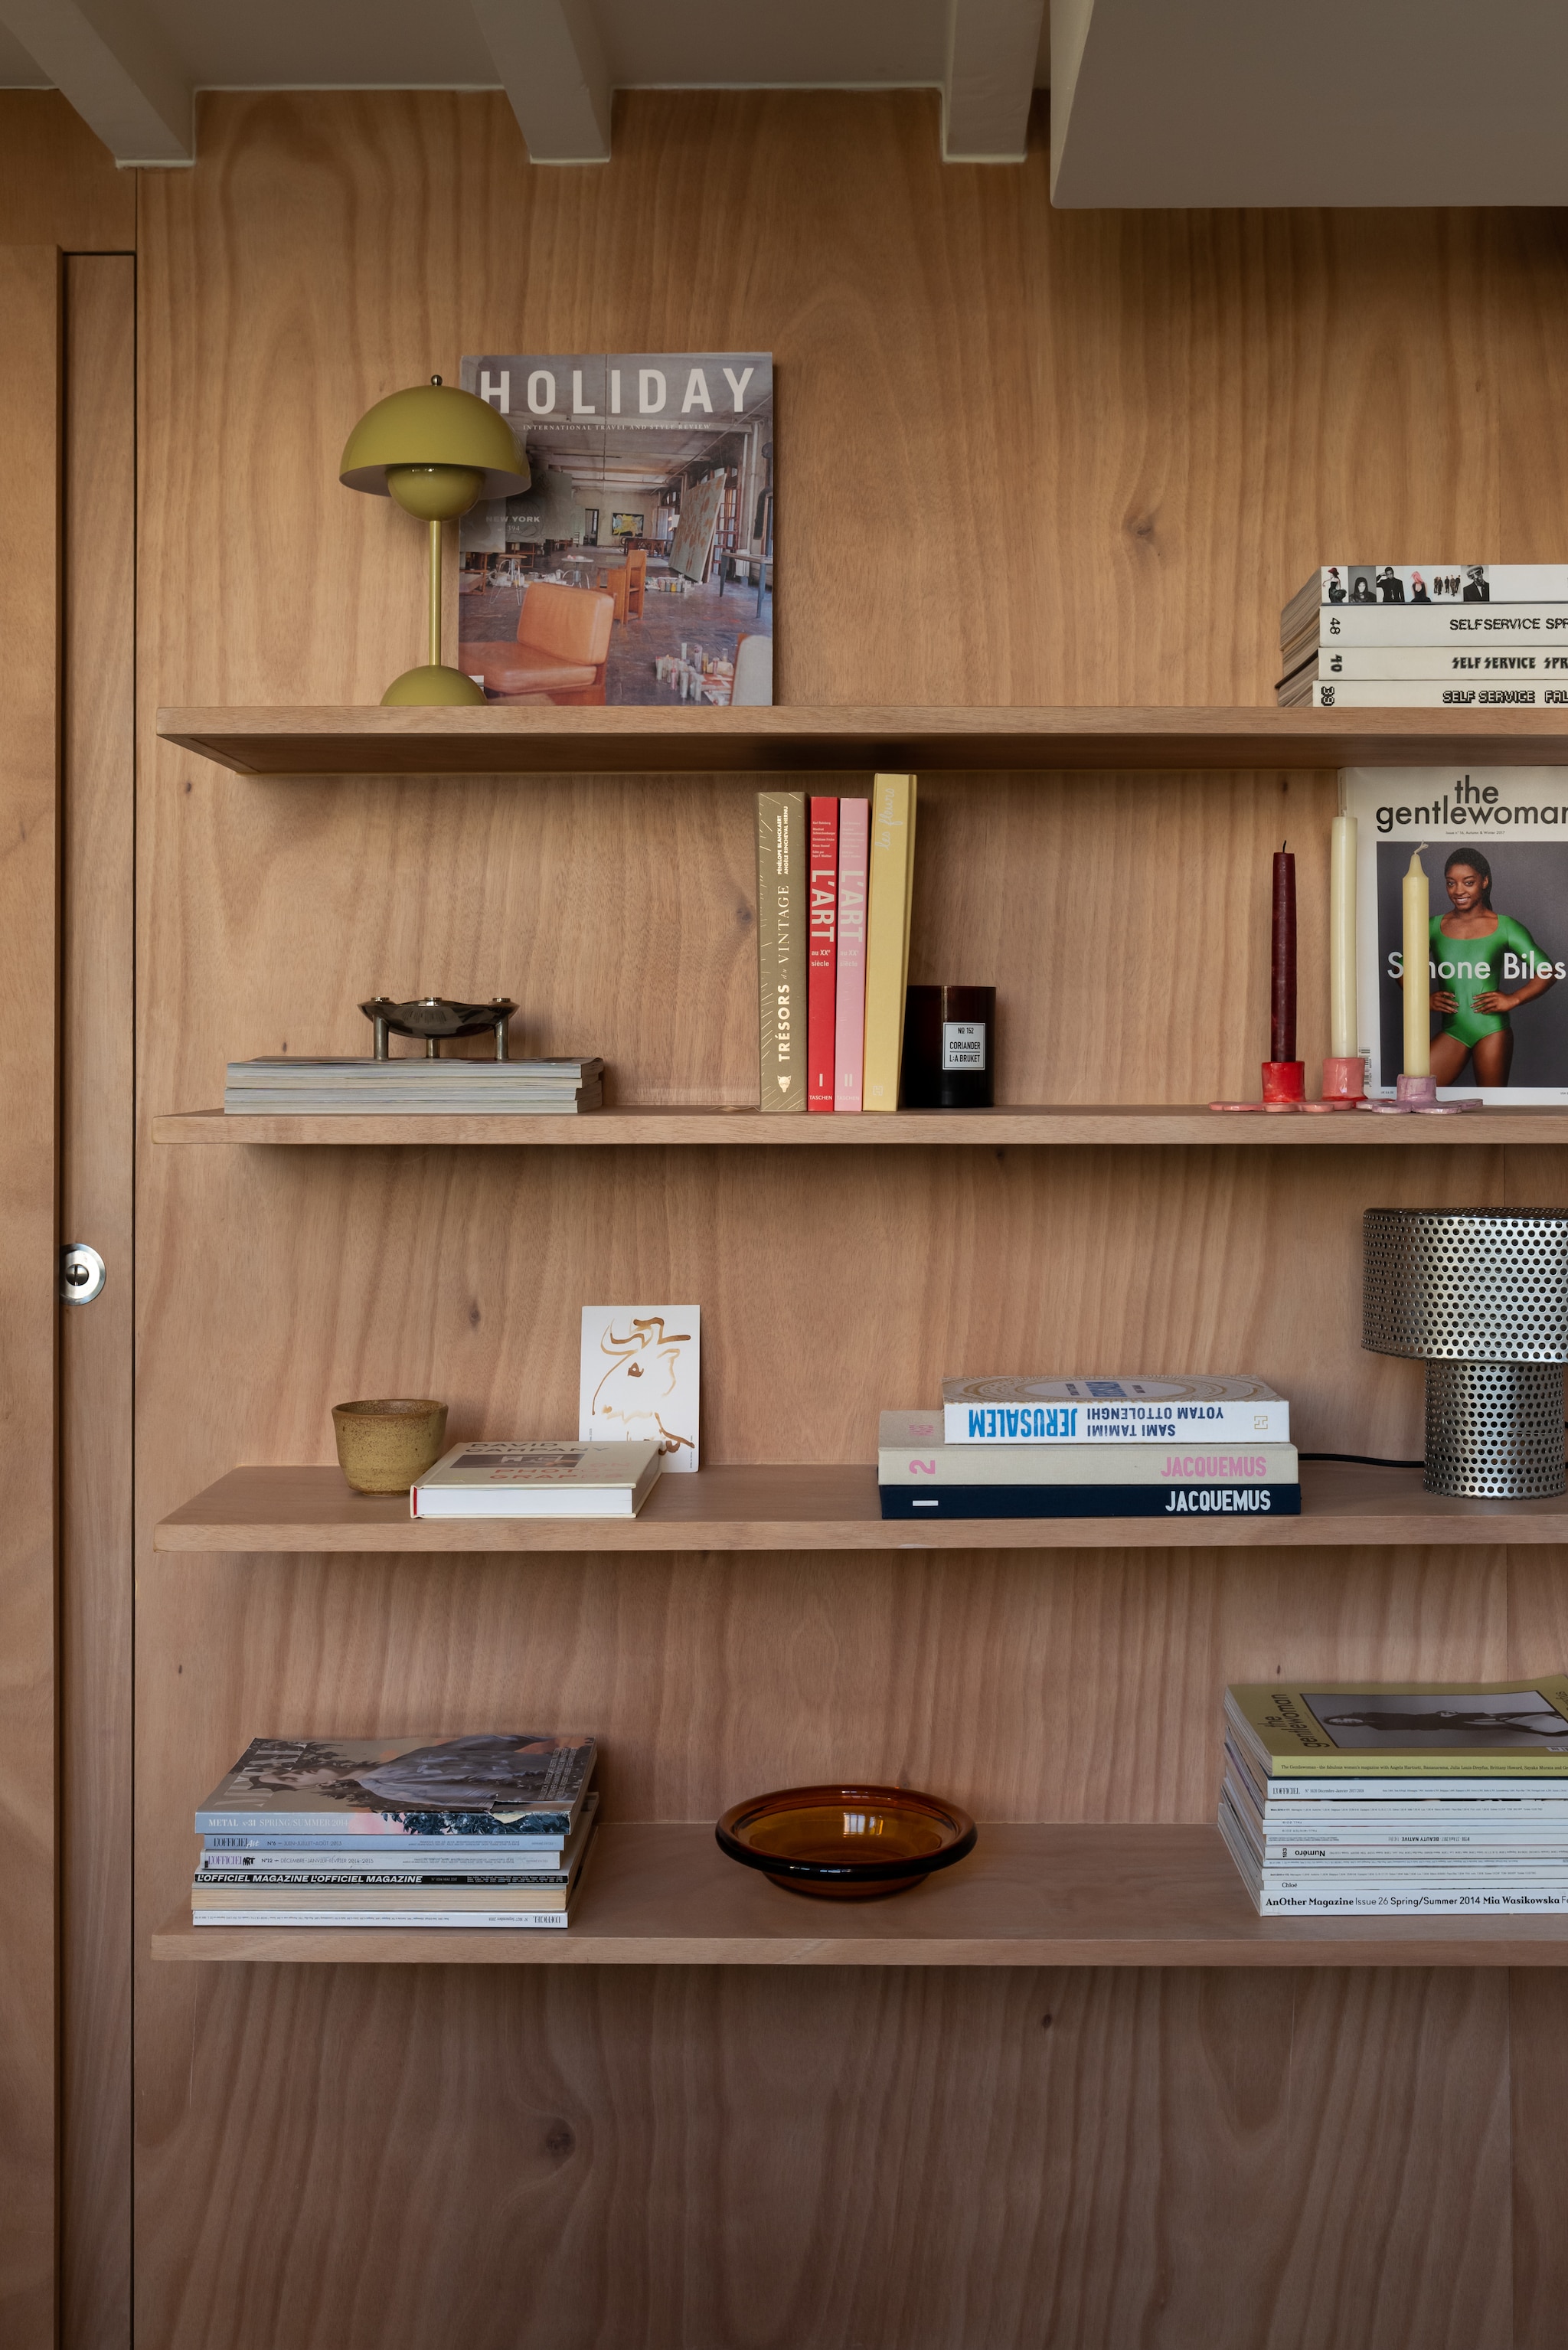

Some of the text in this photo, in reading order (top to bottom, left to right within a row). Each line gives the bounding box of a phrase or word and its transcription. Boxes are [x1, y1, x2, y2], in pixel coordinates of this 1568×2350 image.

[480, 367, 754, 414] HOLIDAY
[1330, 617, 1341, 636] 48
[1330, 654, 1343, 672] 40
[1452, 657, 1481, 669] SELF
[1484, 657, 1537, 669] SERVICE
[1321, 686, 1336, 706] 39
[1442, 690, 1476, 704] SELF
[1478, 690, 1536, 704] SERVICE
[1454, 774, 1499, 804] the
[874, 788, 903, 851] les fleurs
[812, 870, 835, 943] L'ART
[840, 870, 864, 943] L'ART
[778, 885, 789, 964] VINTAGE
[1387, 950, 1566, 979] Sone Biles
[775, 984, 790, 1062] TRÉSORS
[969, 1408, 1078, 1437] JERUSALEM
[1087, 1407, 1224, 1420] YOTAM OTTOLENGHI
[1087, 1423, 1177, 1437] SAMI TAMIMI
[909, 1459, 936, 1474] 2
[1161, 1456, 1267, 1478] JACQUEMUS
[1165, 1489, 1271, 1512] JACQUEMUS
[1257, 1716, 1288, 1727] the
[1271, 1694, 1331, 1748] gentlewoman
[208, 1819, 348, 1828] METAL SPRING/SUMMER 2014
[214, 1838, 248, 1847] L'OFFICIEL
[243, 1856, 256, 1866] ART
[1266, 1897, 1307, 1906] AnOther
[1309, 1897, 1354, 1907] Magazine
[1378, 1897, 1388, 1905] 26
[1390, 1897, 1458, 1907] Spring/Summer
[1459, 1896, 1480, 1904] 2014
[1482, 1896, 1501, 1904] Mia
[1501, 1896, 1560, 1905] Wasikowska
